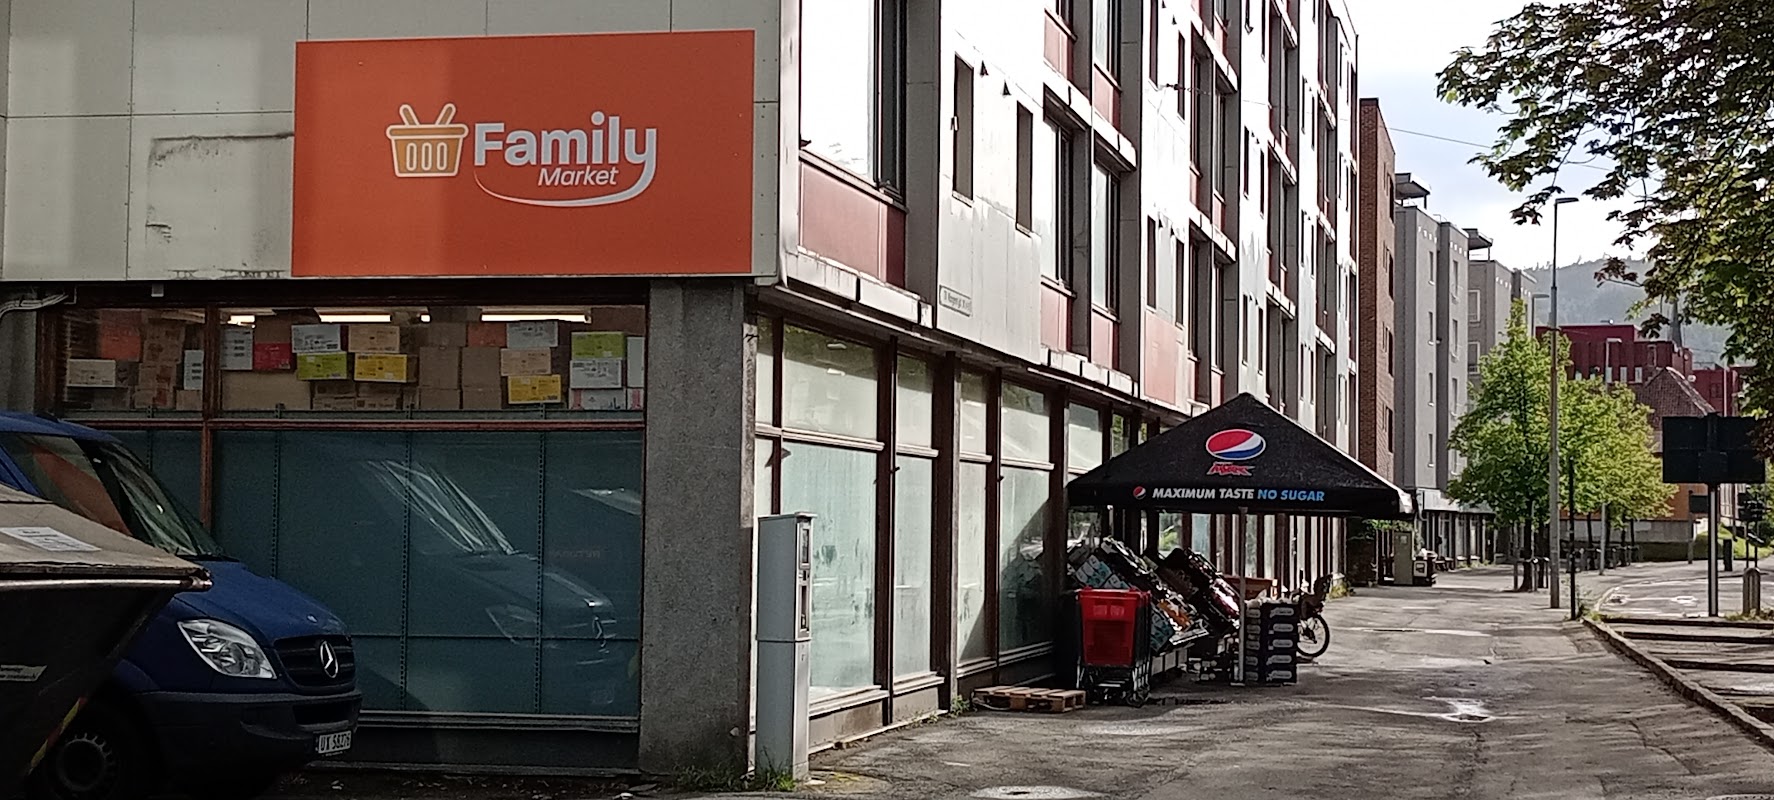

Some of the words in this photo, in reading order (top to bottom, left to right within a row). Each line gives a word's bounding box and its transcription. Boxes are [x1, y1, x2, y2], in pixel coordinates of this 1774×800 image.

[474, 111, 657, 200] Family
[537, 165, 619, 187] Market
[1152, 487, 1216, 499] MAXIMUM
[1219, 488, 1254, 500] TASTE
[1257, 489, 1277, 500] NO
[1280, 490, 1325, 502] SUGAR
